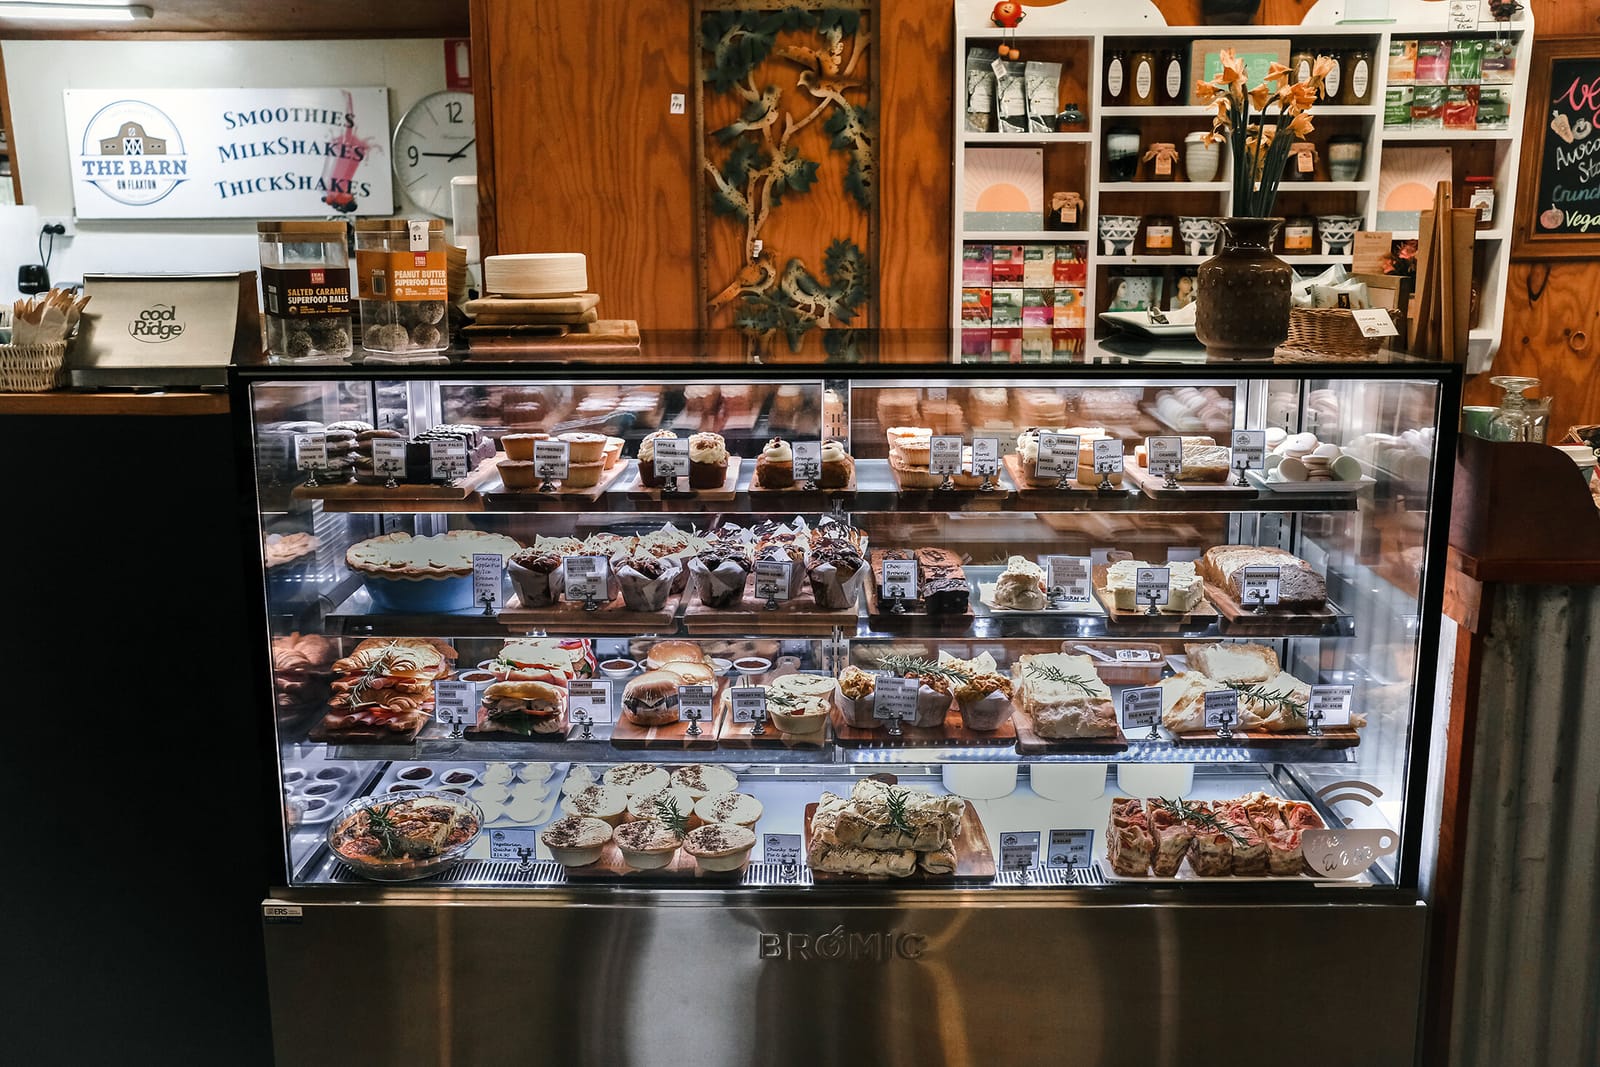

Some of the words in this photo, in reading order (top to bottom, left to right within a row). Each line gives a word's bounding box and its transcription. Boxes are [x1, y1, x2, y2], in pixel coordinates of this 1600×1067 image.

[445, 101, 463, 124] 12
[407, 145, 419, 167] 9
[82, 160, 125, 176] THE
[129, 159, 187, 175] BARN
[117, 180, 126, 190] ON
[128, 179, 157, 190] FLAXTON
[394, 270, 420, 279] PEANUT
[422, 270, 446, 279] BUTTER
[395, 279, 428, 287] SUPERFOOD
[430, 278, 447, 286] BALLS
[287, 288, 314, 296] SALTED
[316, 287, 349, 295] CARAMEL
[287, 296, 328, 304] SUPERFOOD
[329, 295, 349, 303] BALLS
[140, 305, 176, 321] cool
[133, 320, 182, 339] Ridge
